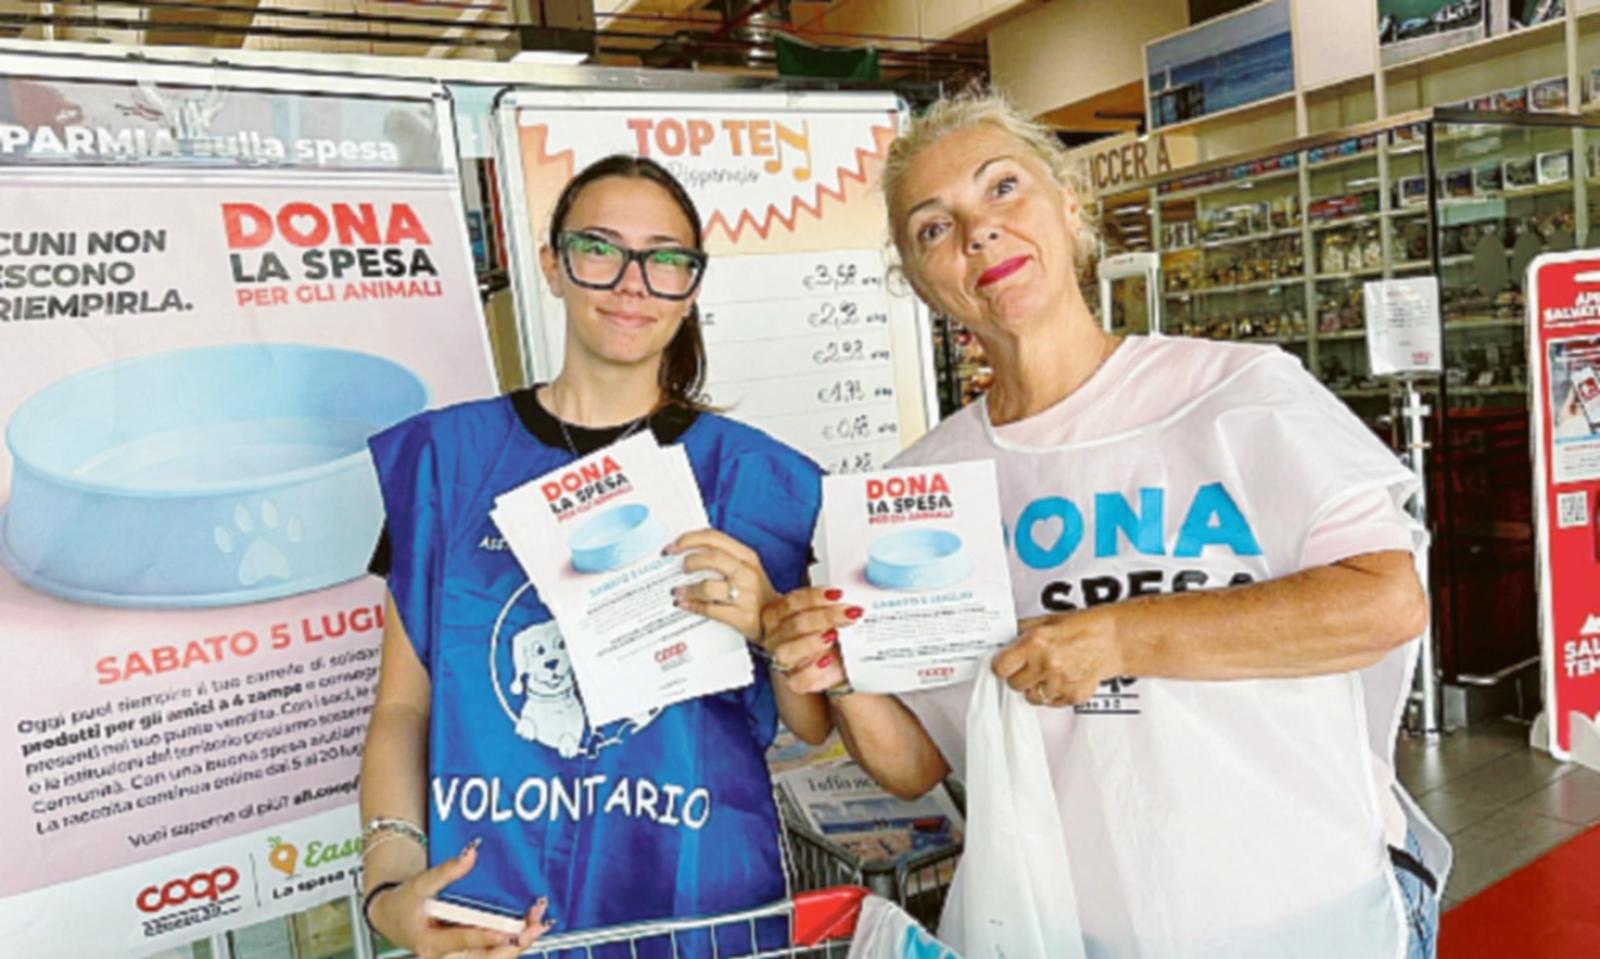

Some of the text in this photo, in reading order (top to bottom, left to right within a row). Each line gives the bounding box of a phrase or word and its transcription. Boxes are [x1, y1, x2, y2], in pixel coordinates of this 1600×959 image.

[295, 137, 399, 165] spesa
[627, 117, 812, 182] TOP TEN
[88, 229, 166, 255] NON
[221, 201, 432, 249] DONA
[0, 261, 135, 289] SCONO
[229, 247, 438, 283] LA SPESA
[236, 279, 444, 307] PER GLI ANIMALI
[541, 454, 622, 503] DONA
[550, 473, 630, 514] LA SPESA
[866, 472, 952, 500] DONA
[867, 494, 953, 515] LA SPESA
[1001, 482, 1264, 570] ONA
[95, 630, 259, 685] SABATO
[270, 623, 292, 651] 5
[17, 713, 66, 734] Oggi
[22, 723, 101, 757] prodotti
[105, 719, 135, 738] per
[139, 711, 163, 730] gli
[167, 698, 215, 721] amici
[219, 700, 229, 711] a
[232, 694, 244, 706] 4
[247, 682, 302, 704] zampe
[26, 745, 100, 776] presenti
[281, 699, 312, 715] Con
[131, 772, 166, 790] Con
[169, 762, 203, 781] una
[205, 748, 259, 772] buona
[261, 739, 307, 760] spesa
[36, 819, 60, 836] La
[136, 780, 211, 809] continua
[214, 768, 264, 790] online
[292, 755, 302, 770] 5
[320, 747, 340, 764] 20
[431, 774, 711, 830] VOLONTARIO
[128, 825, 168, 848] Vuoi
[170, 810, 237, 839] saperne
[136, 865, 240, 913] coop
